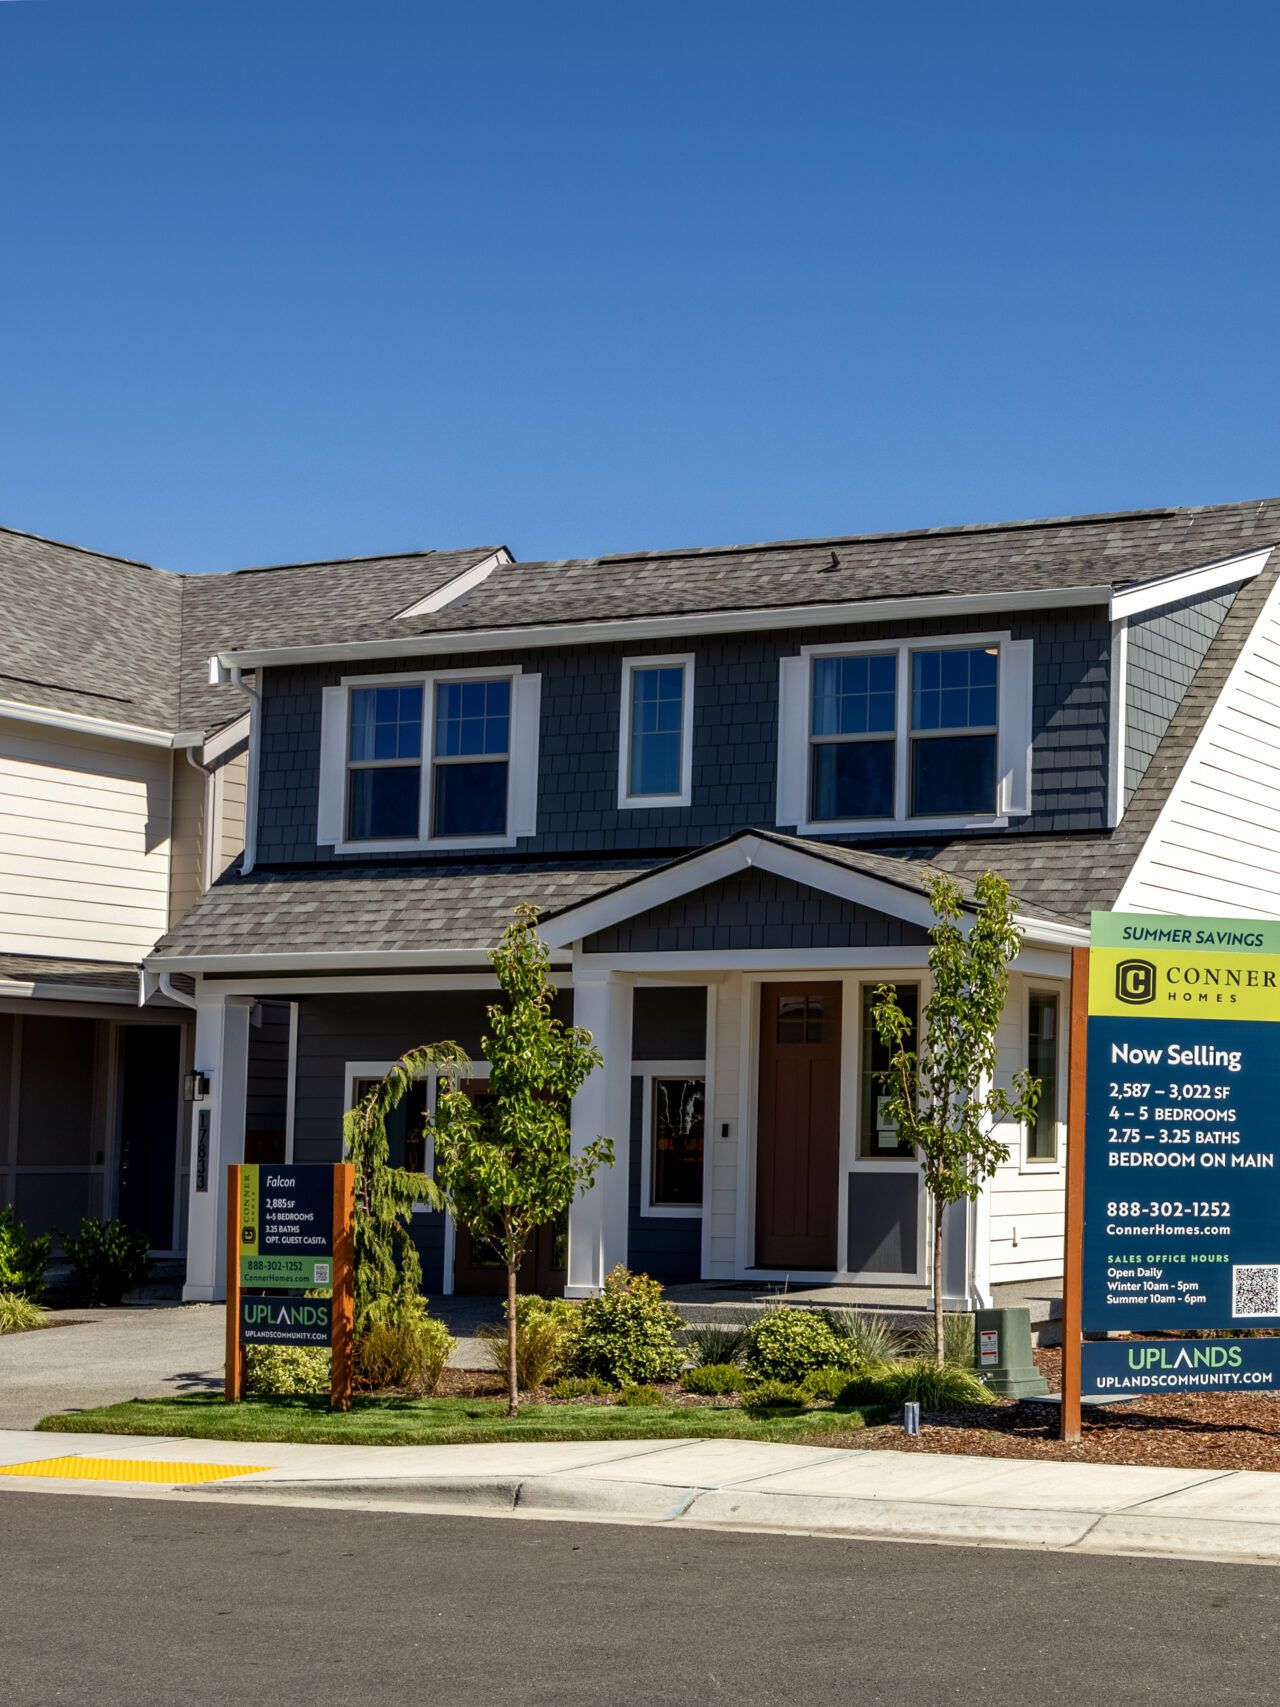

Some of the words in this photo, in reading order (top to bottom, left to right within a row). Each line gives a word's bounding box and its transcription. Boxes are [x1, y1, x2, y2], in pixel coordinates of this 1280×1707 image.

[1123, 927, 1191, 944] SUMMER
[1196, 931, 1263, 947] SAVINGS
[1166, 967, 1277, 987] CONNER
[1169, 993, 1236, 1003] HOMES
[1112, 1044, 1162, 1064] Now
[1168, 1044, 1242, 1072] Selling
[1109, 1083, 1150, 1100] 2,587
[1170, 1084, 1211, 1101] 3,022
[1214, 1087, 1230, 1099] SF
[1109, 1106, 1119, 1119] 4
[1139, 1107, 1148, 1120] 5
[1155, 1109, 1236, 1121] BEDROOMS
[1109, 1129, 1139, 1143] 2.75
[1160, 1130, 1190, 1143] 3.25
[1196, 1132, 1240, 1144] BATHS
[197, 1113, 207, 1189] 17833
[1109, 1153, 1195, 1167] BEDROOM
[1200, 1154, 1225, 1167] ON
[1232, 1154, 1273, 1167] MAIN
[267, 1175, 295, 1187] Falcon
[266, 1199, 287, 1209] 2,885
[1107, 1202, 1230, 1217] 888-302-1252
[1106, 1224, 1230, 1235] ConnerHomes.com
[1108, 1255, 1141, 1263] SALES
[1147, 1255, 1186, 1263] OFFICE
[1192, 1254, 1230, 1263] HOURS
[248, 1261, 302, 1271] 888-302-1252
[1108, 1268, 1134, 1279] Open
[1137, 1267, 1162, 1279] Daily
[245, 1274, 309, 1283] ConnerHomes.com
[1108, 1281, 1141, 1290] Winter
[1143, 1282, 1168, 1290] 10am
[1177, 1282, 1198, 1292] 5pm
[1107, 1295, 1148, 1304] Summer
[1150, 1295, 1175, 1303] 10am
[1184, 1294, 1206, 1305] 6pm
[245, 1305, 328, 1325] UPLANDS
[245, 1331, 327, 1340] UPLANDSCOMMUNITY.COM
[1128, 1346, 1242, 1370] UPLANDS
[1097, 1372, 1272, 1388] UPLANDSCOMMUNITY.COM
